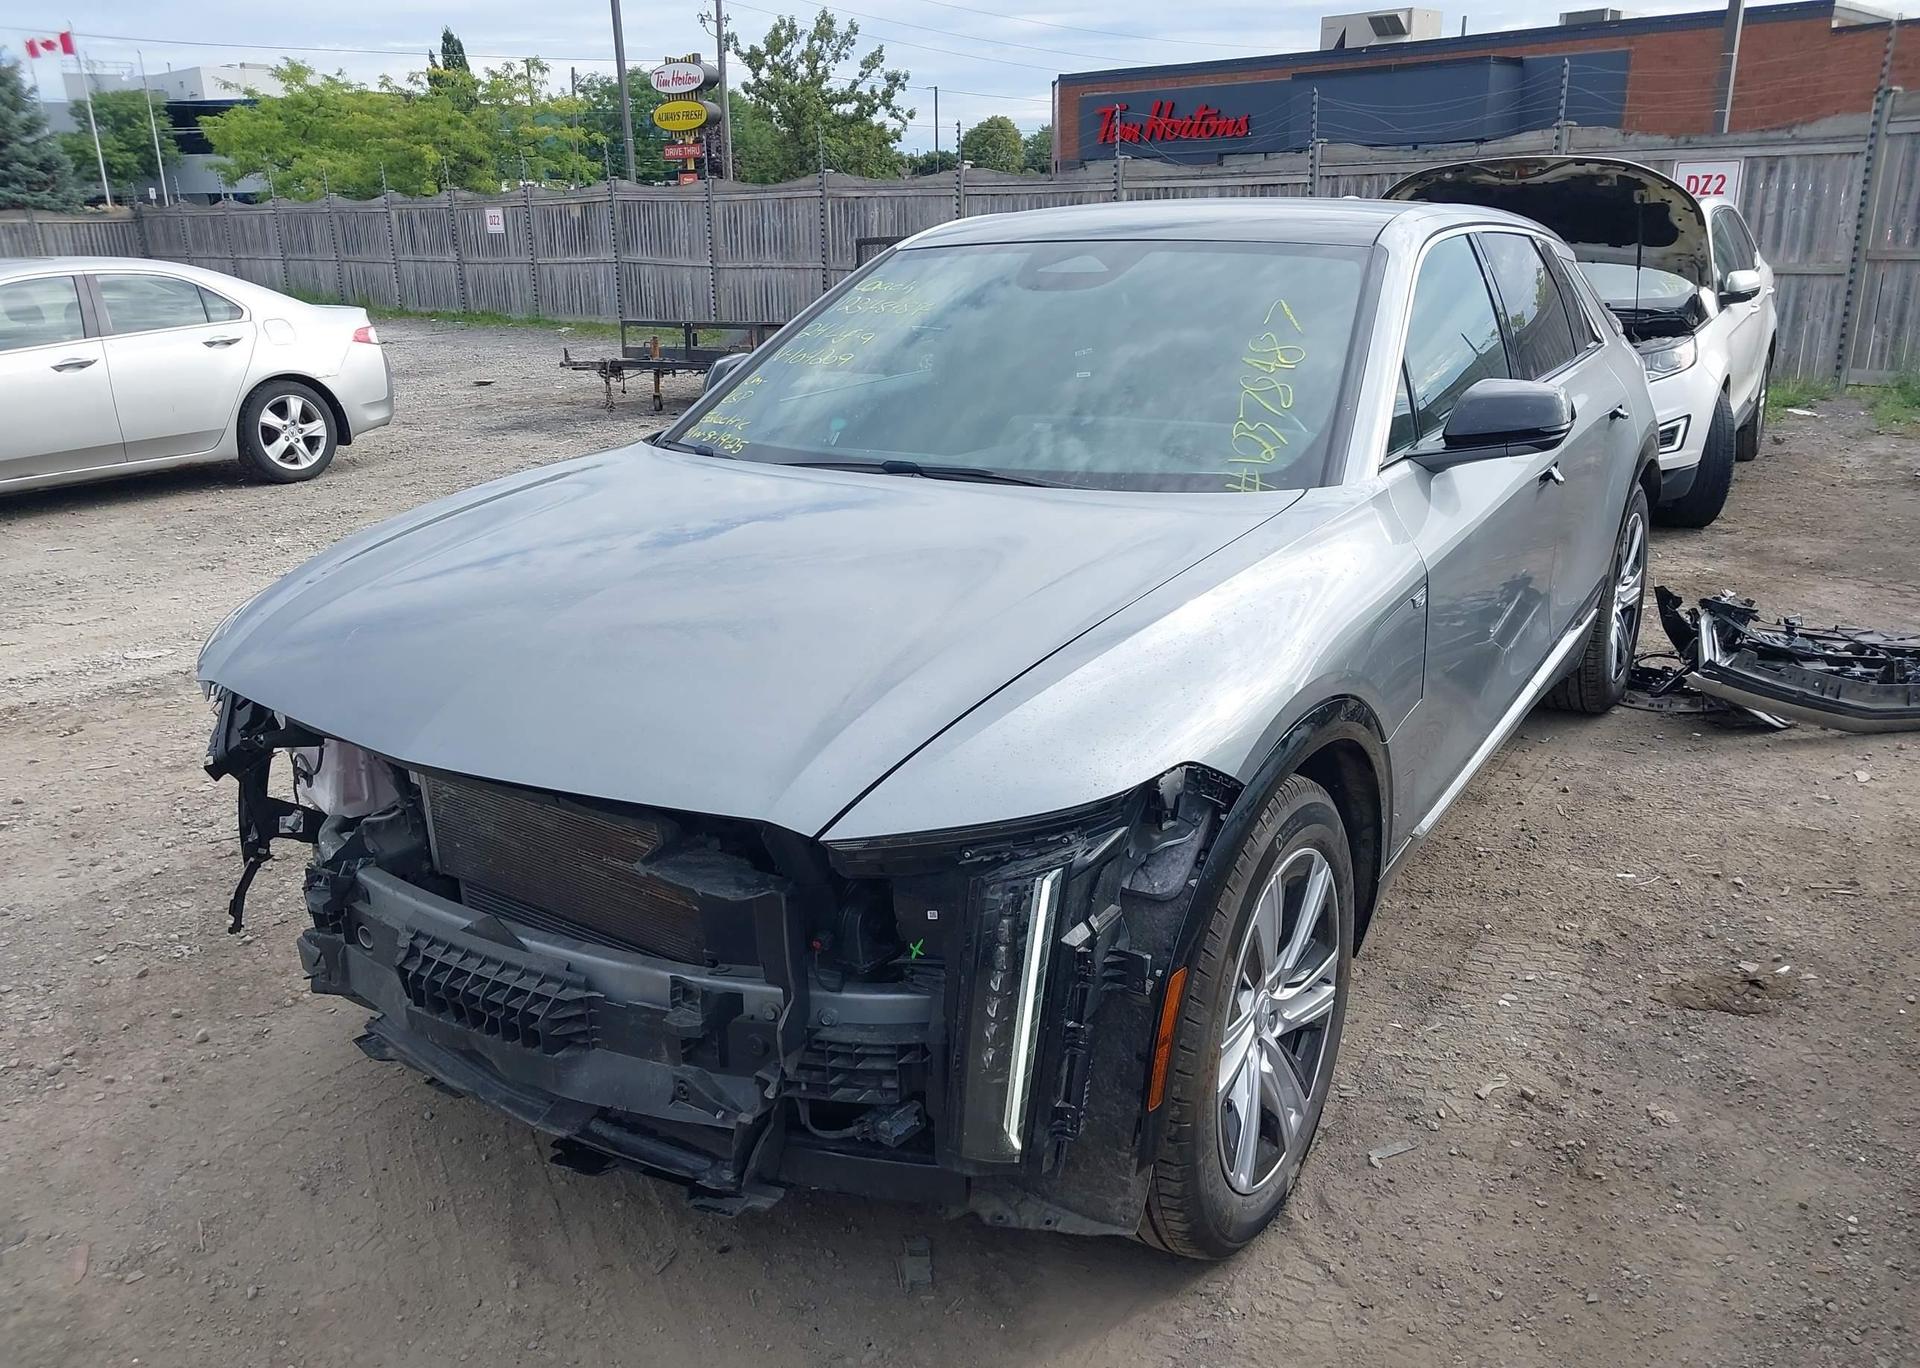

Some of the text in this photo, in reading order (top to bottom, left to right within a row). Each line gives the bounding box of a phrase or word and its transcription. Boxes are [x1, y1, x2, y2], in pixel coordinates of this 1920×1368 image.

[655, 70, 701, 88] Tim Hortons
[657, 109, 703, 122] ALWAYS FRESH
[1095, 99, 1250, 144] Tim Hortons
[665, 145, 700, 157] DRIVE THRU
[1686, 174, 1727, 195] DZ2
